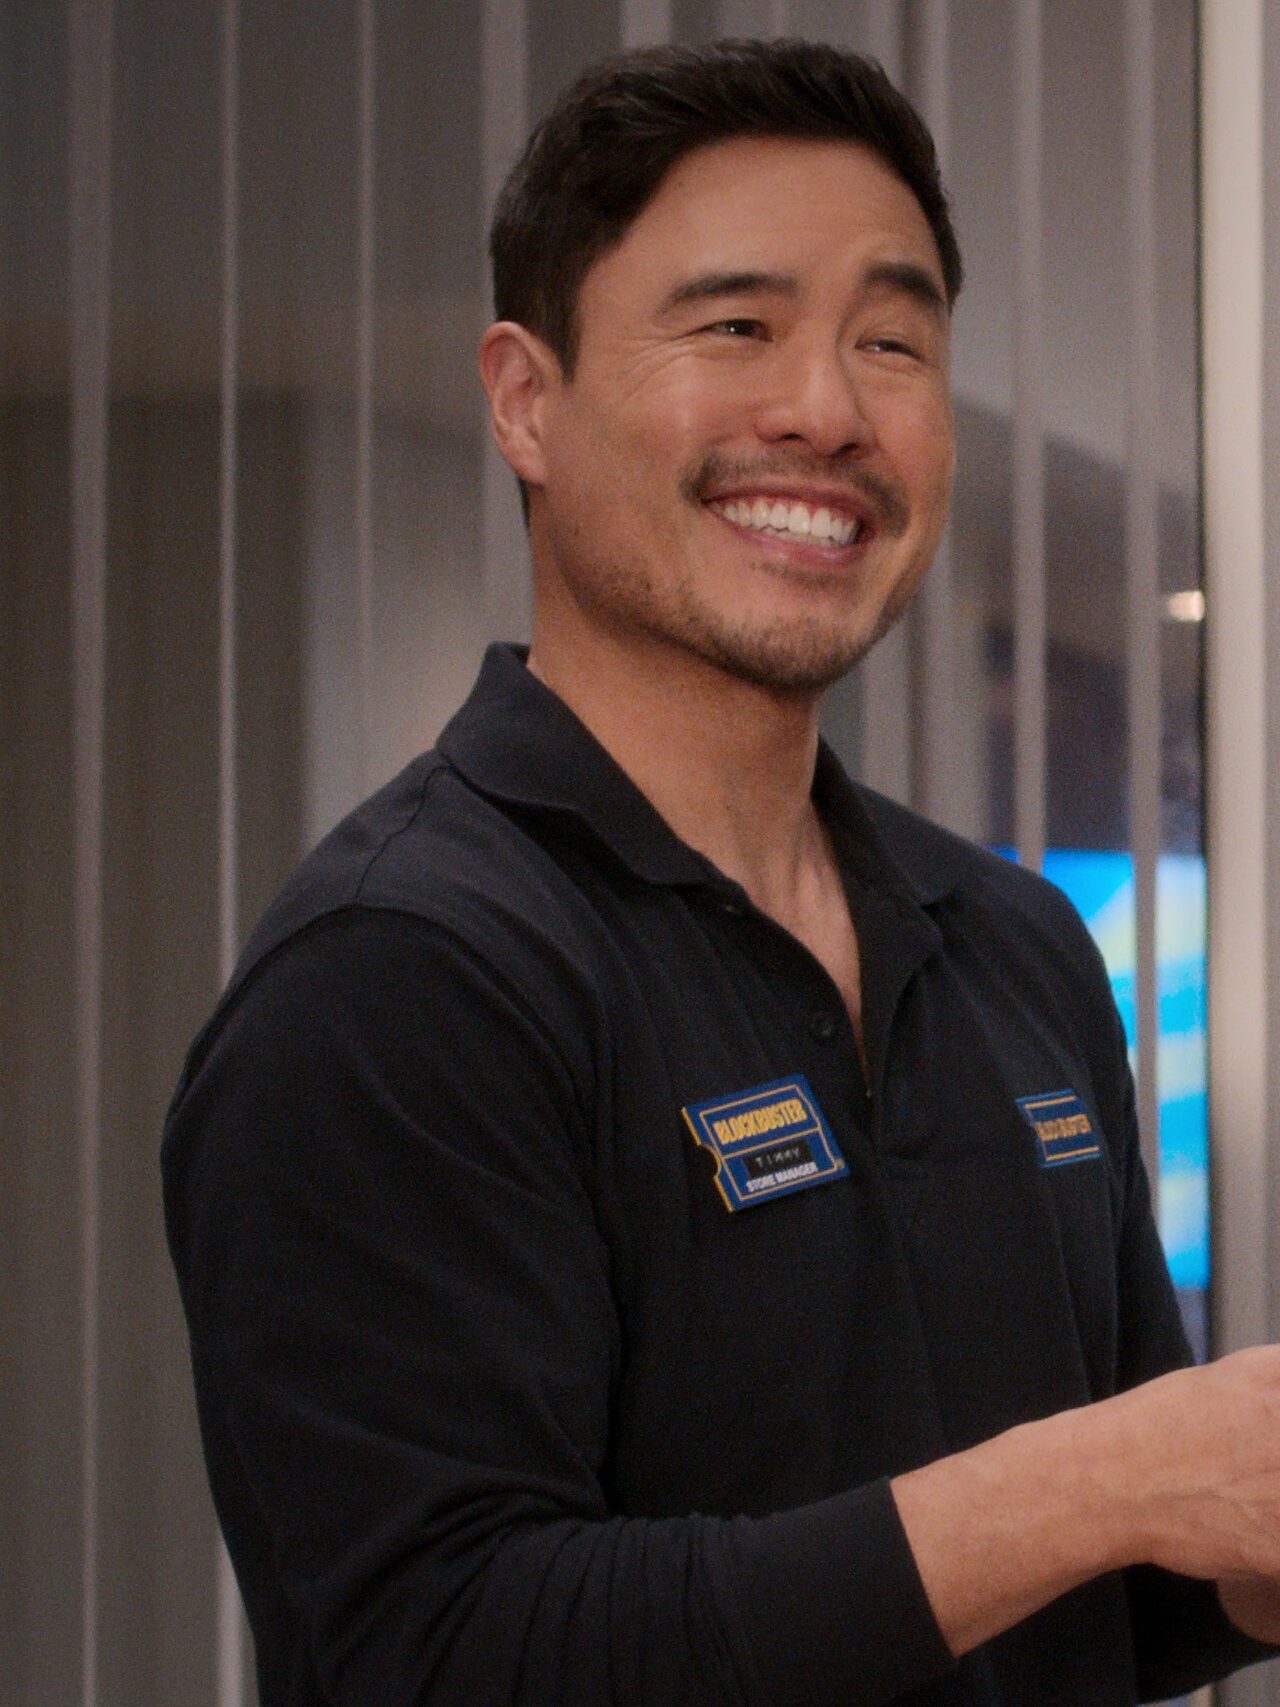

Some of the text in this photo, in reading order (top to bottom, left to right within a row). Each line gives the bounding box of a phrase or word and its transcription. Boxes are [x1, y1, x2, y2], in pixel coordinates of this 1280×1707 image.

[713, 1099, 808, 1145] BLOCKBUSTER
[746, 1161, 819, 1192] STORE MANAGER
